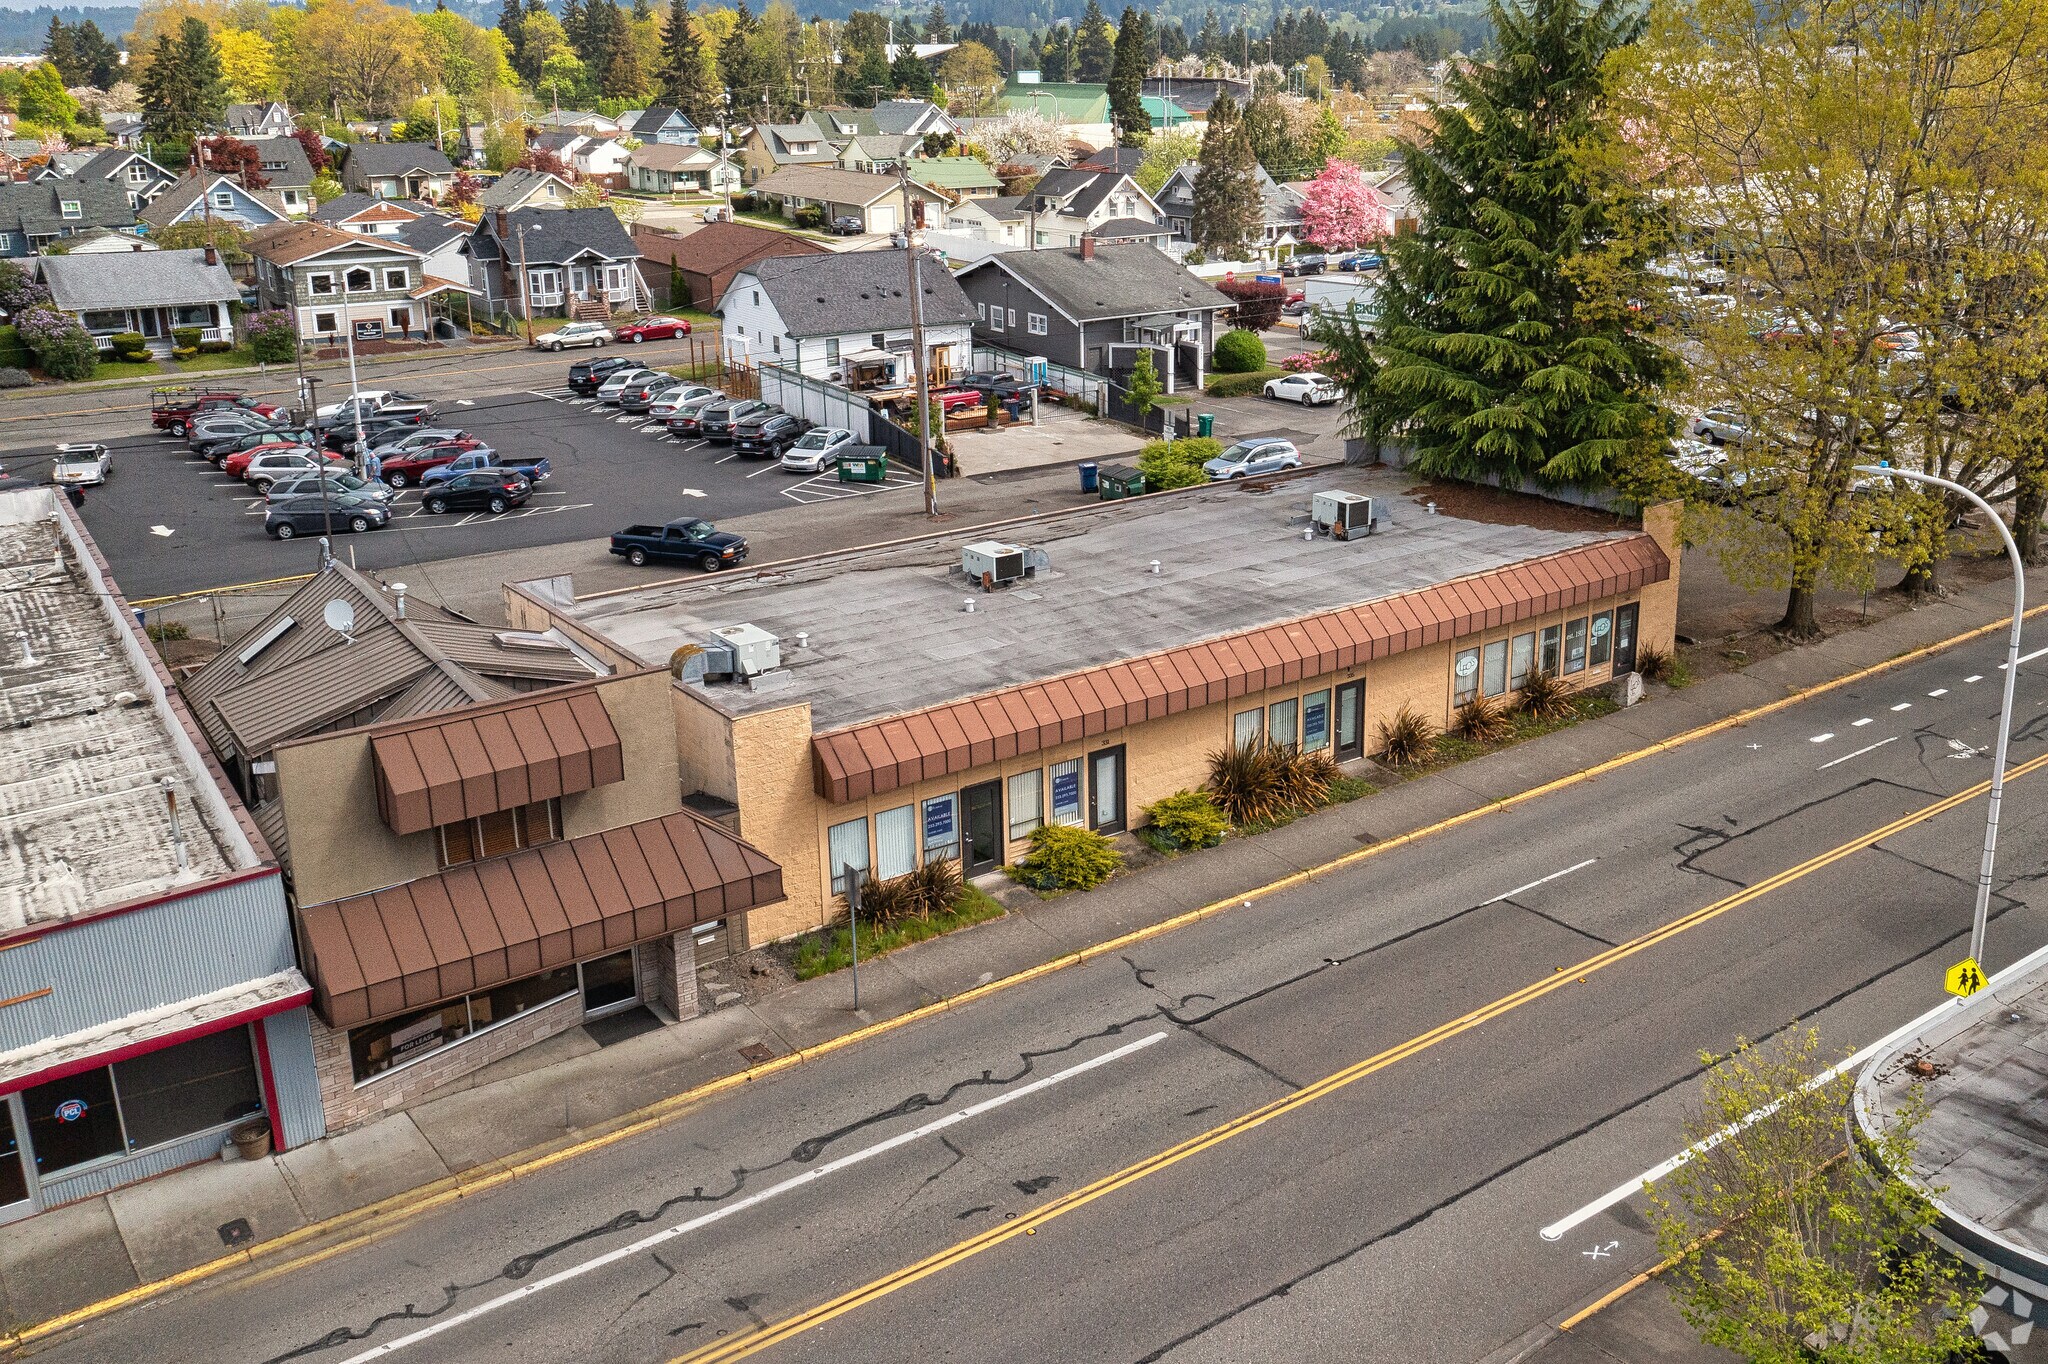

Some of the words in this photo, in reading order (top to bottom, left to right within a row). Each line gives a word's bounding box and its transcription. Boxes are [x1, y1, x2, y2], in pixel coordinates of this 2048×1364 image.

[927, 811, 951, 822] AVAILABLE
[400, 1041, 414, 1052] FOR
[414, 1032, 435, 1045] LEASE
[64, 1108, 79, 1117] PCL
